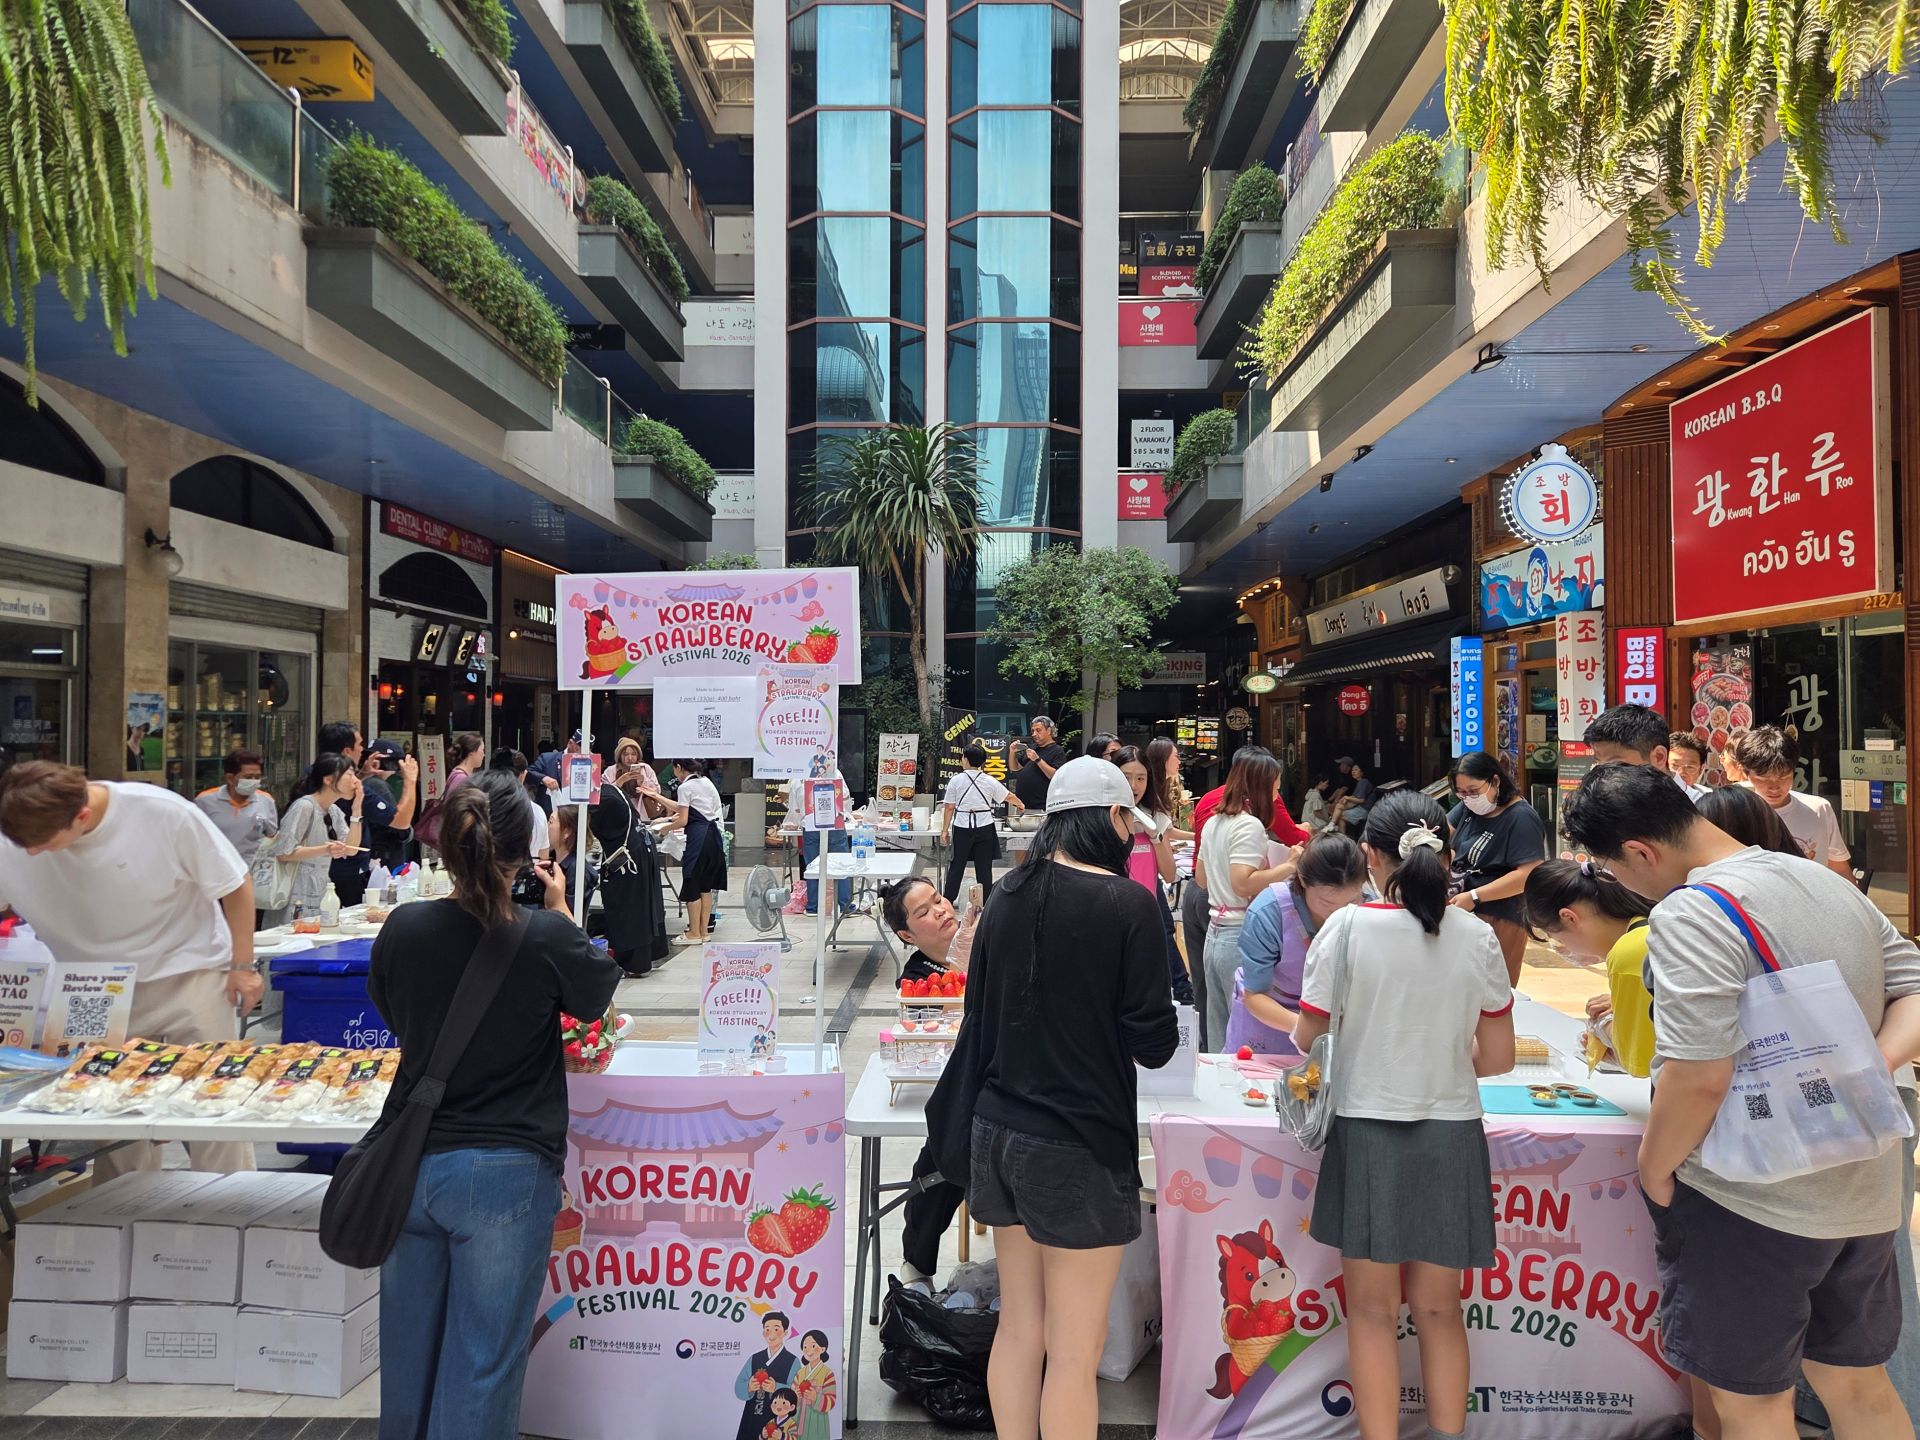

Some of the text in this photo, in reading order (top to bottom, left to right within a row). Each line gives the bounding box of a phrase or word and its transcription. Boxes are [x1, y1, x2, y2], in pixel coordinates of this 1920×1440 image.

[1140, 324, 1163, 332] 사랑해
[1684, 383, 1782, 439] KOREAN B.B.Q
[1836, 476, 1853, 490] Roo
[1127, 496, 1150, 504] 사랑해
[1539, 489, 1571, 526] 회
[1727, 491, 1800, 521] Kwang Han
[390, 508, 448, 541] DENTAL CLINIC
[1864, 591, 1904, 609] 212/1
[531, 602, 548, 624] HAN
[658, 602, 753, 626] KOREAN
[627, 624, 787, 661] STRAWBERRY
[662, 649, 751, 666] FESTIVAL 2026
[1624, 637, 1645, 679] BBQ
[1645, 636, 1657, 679] Korean
[771, 688, 823, 700] STRAWBERRY
[770, 708, 819, 727] FREE!!!
[944, 713, 975, 742] GENKI
[775, 737, 817, 746] TASTING
[986, 738, 1007, 747] 이발소
[64, 973, 127, 983] Share your
[717, 969, 765, 980] STRAWBERRY
[1, 988, 28, 999] TAG
[62, 984, 103, 993] Review
[714, 988, 761, 1006] FREE!!!
[718, 1018, 758, 1026] TASTING
[581, 1165, 751, 1206] KOREAN
[548, 1242, 818, 1308] TRAWBERRY
[576, 1288, 748, 1323] FESTIVAL 2026
[1511, 1306, 1577, 1347] 2026
[569, 1335, 661, 1351] aT 한국농수산식품유통공사
[700, 1341, 741, 1350] 한국문화원
[1467, 1387, 1634, 1413] aT 한국농수산식품유통공사
[1597, 1408, 1633, 1416] Corporation
